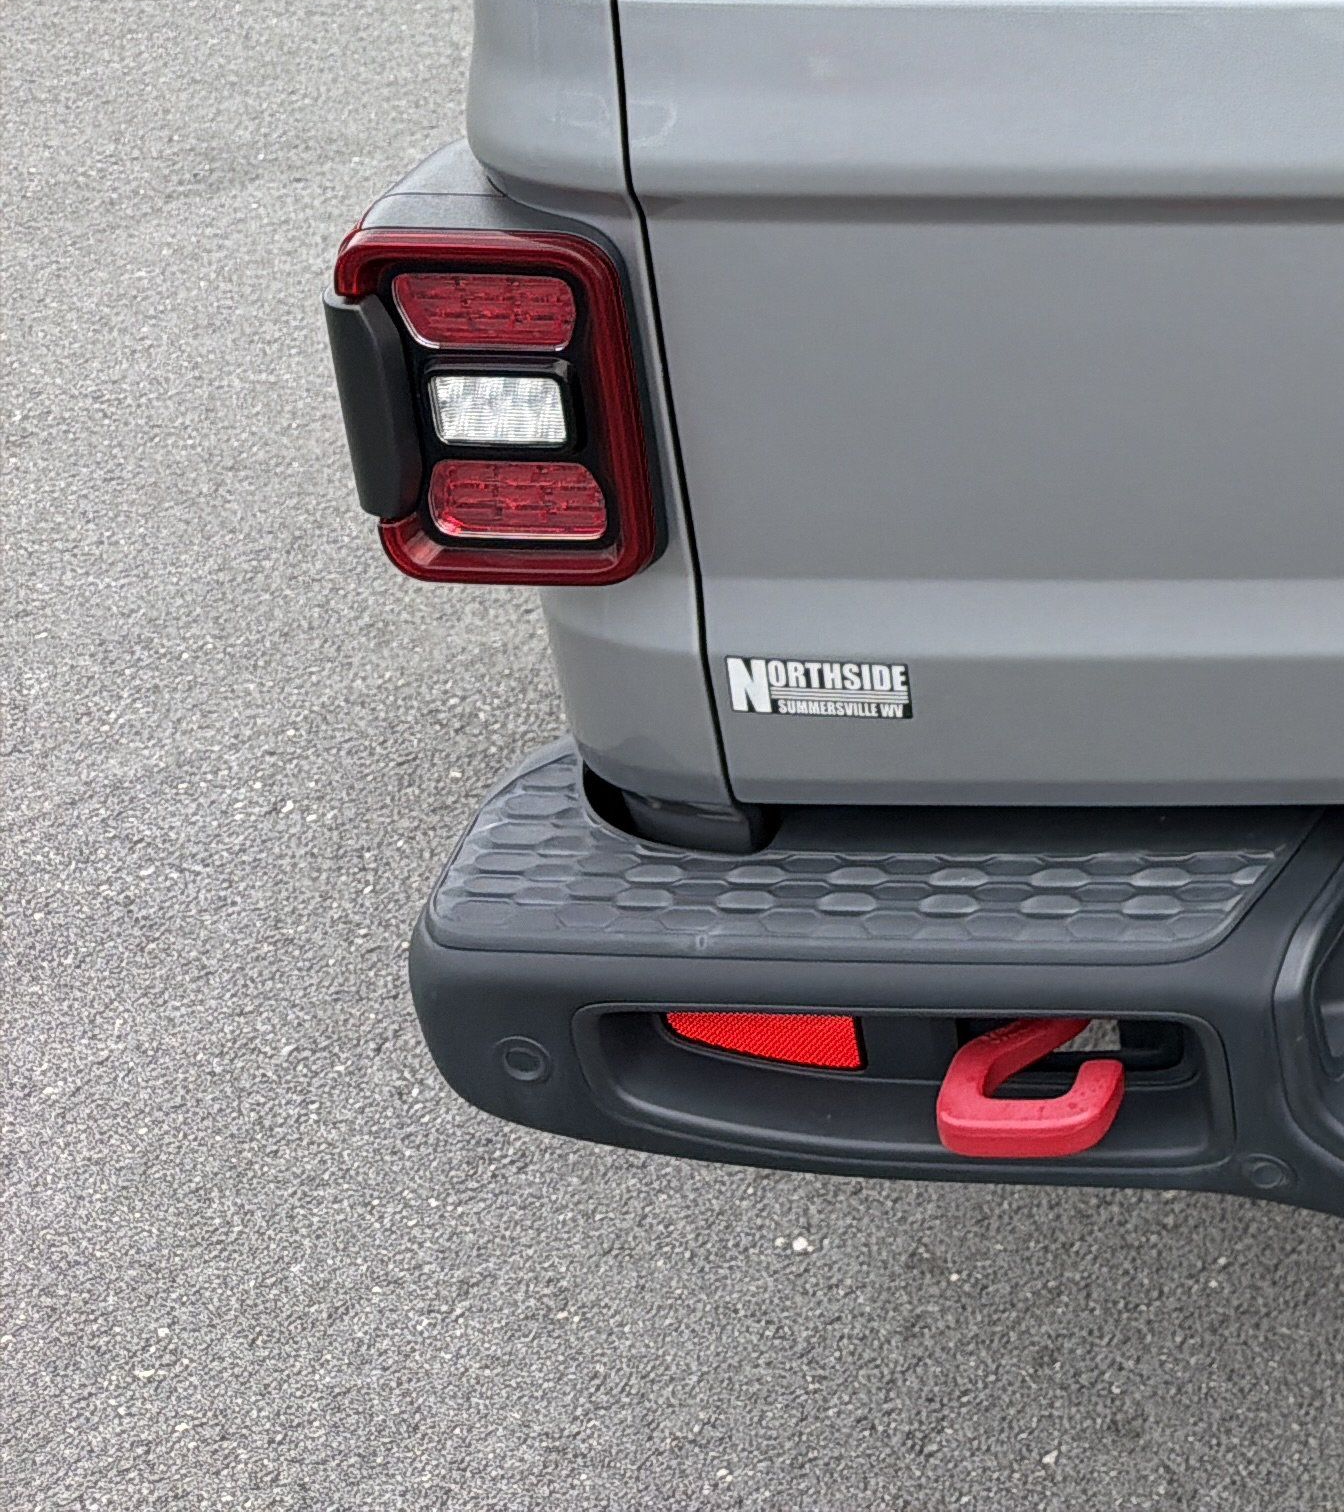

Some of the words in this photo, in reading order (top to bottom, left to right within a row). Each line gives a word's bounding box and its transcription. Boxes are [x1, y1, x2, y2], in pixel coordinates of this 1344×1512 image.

[726, 657, 909, 714] NORTHSIDE
[778, 699, 878, 717] SUMMERSVILLE
[881, 703, 904, 718] WV
